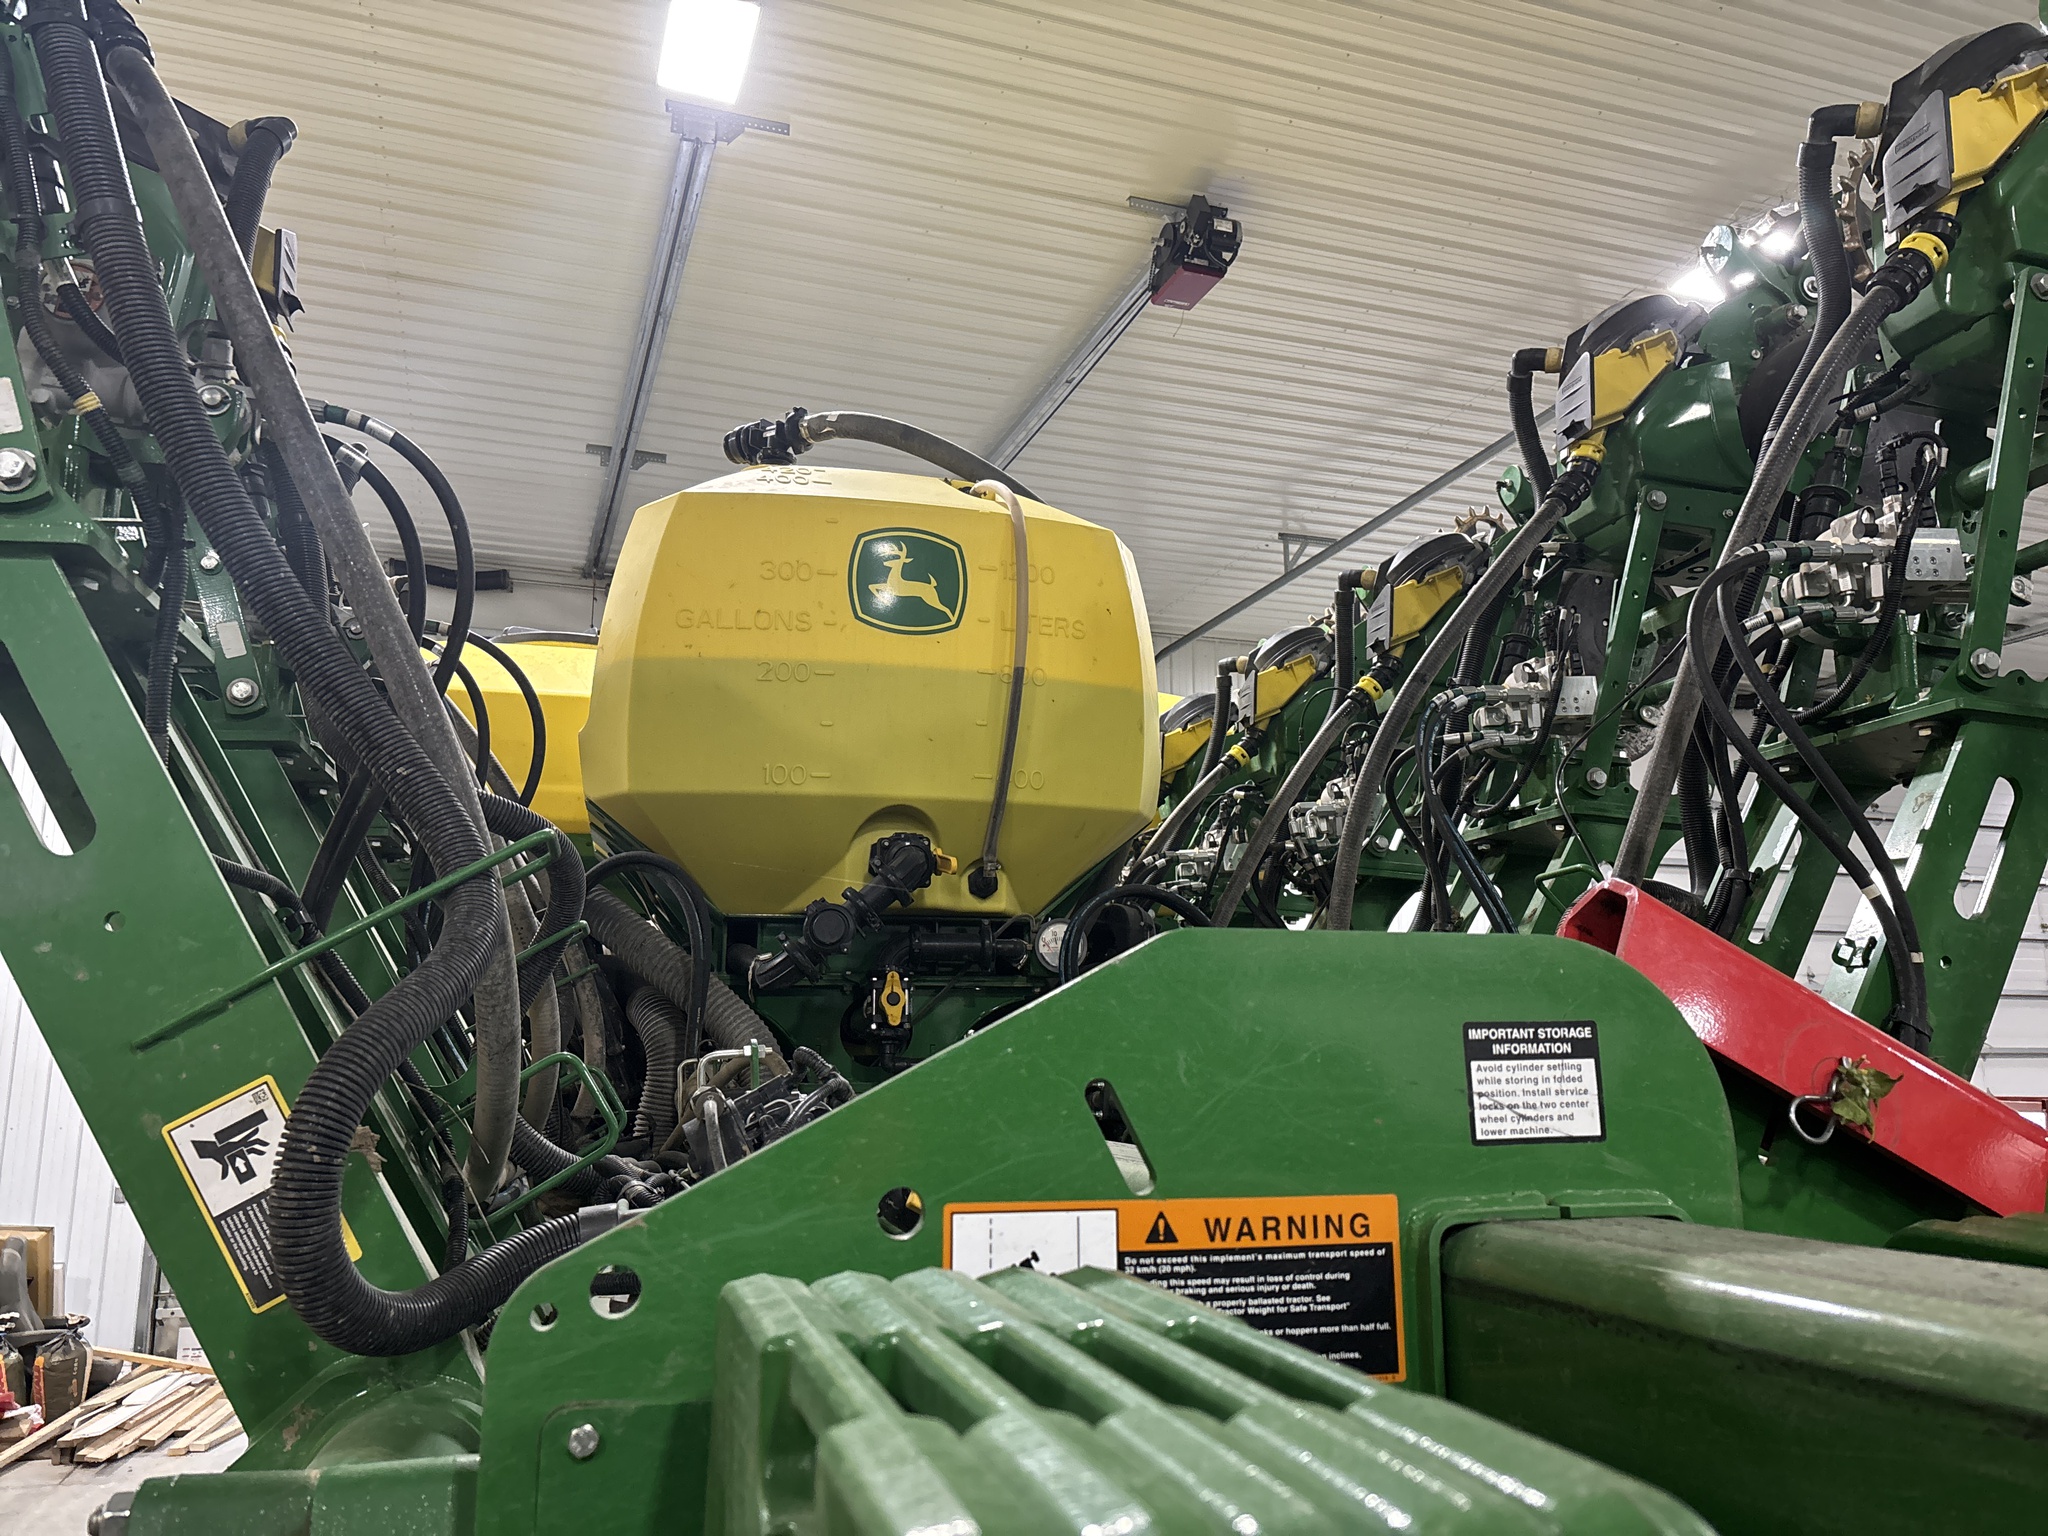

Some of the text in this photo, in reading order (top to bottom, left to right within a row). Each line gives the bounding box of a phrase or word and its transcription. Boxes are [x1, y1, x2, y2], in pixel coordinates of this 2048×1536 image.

[761, 465, 812, 475] 420
[757, 475, 809, 485] 400
[759, 560, 813, 582] 300
[675, 608, 813, 632] GALLONS
[756, 661, 811, 682] 200
[762, 763, 807, 785] 100
[1468, 1027, 1592, 1040] IMPORTANT STORAGE
[1492, 1042, 1572, 1054] INFORMATION
[1476, 1063, 1582, 1074] Avoid cylinder settling
[1477, 1075, 1583, 1086] while storing in folded
[1478, 1087, 1589, 1099] position. Install service
[1479, 1102, 1504, 1110] locks
[1522, 1101, 1537, 1109] the
[1560, 1100, 1589, 1108] center
[1480, 1113, 1574, 1125] wheel cylinders and
[1481, 1126, 1553, 1136] lower machine.
[248, 1210, 265, 1238] disconnected
[1204, 1212, 1370, 1242] WARNING
[226, 1217, 236, 1231] before
[233, 1231, 247, 1254] attempting
[245, 1254, 255, 1270] service
[238, 1211, 246, 1222] Refer
[257, 1250, 268, 1266] Manual
[232, 1214, 242, 1228] relieve
[242, 1234, 252, 1250] system
[250, 1249, 262, 1269] hydraulic
[260, 1269, 272, 1289] pressure
[1124, 1257, 1137, 1265] Do
[1139, 1256, 1154, 1264] not
[1156, 1256, 1188, 1264] exceed
[1190, 1255, 1207, 1263] this
[1210, 1253, 1262, 1264] implement's
[1265, 1252, 1306, 1260] maximum
[1308, 1250, 1347, 1260] transport
[1350, 1249, 1374, 1258] speed
[1125, 1265, 1197, 1275] 32 km/h (20 mph).
[1170, 1278, 1184, 1286] this
[1187, 1277, 1211, 1286] speed
[1214, 1277, 1230, 1286] may
[1232, 1275, 1255, 1284] result
[1295, 1273, 1323, 1281] control
[1325, 1272, 1351, 1281] during
[1176, 1287, 1206, 1296] braking
[1225, 1285, 1255, 1293] serious
[1257, 1283, 1280, 1292] injury
[1292, 1282, 1316, 1290] death.
[1213, 1298, 1247, 1308] properly
[1248, 1296, 1284, 1305] ballasted
[1286, 1295, 1314, 1303] tractor.
[1316, 1294, 1331, 1302] See
[1247, 1305, 1275, 1316] Weight
[1277, 1305, 1288, 1313] for
[1290, 1303, 1308, 1312] Safe
[1275, 1327, 1284, 1336] or
[1286, 1326, 1318, 1336] hoppers
[1320, 1325, 1339, 1333] more
[1341, 1324, 1358, 1332] than
[1360, 1323, 1375, 1331] half
[1377, 1322, 1391, 1330] full.
